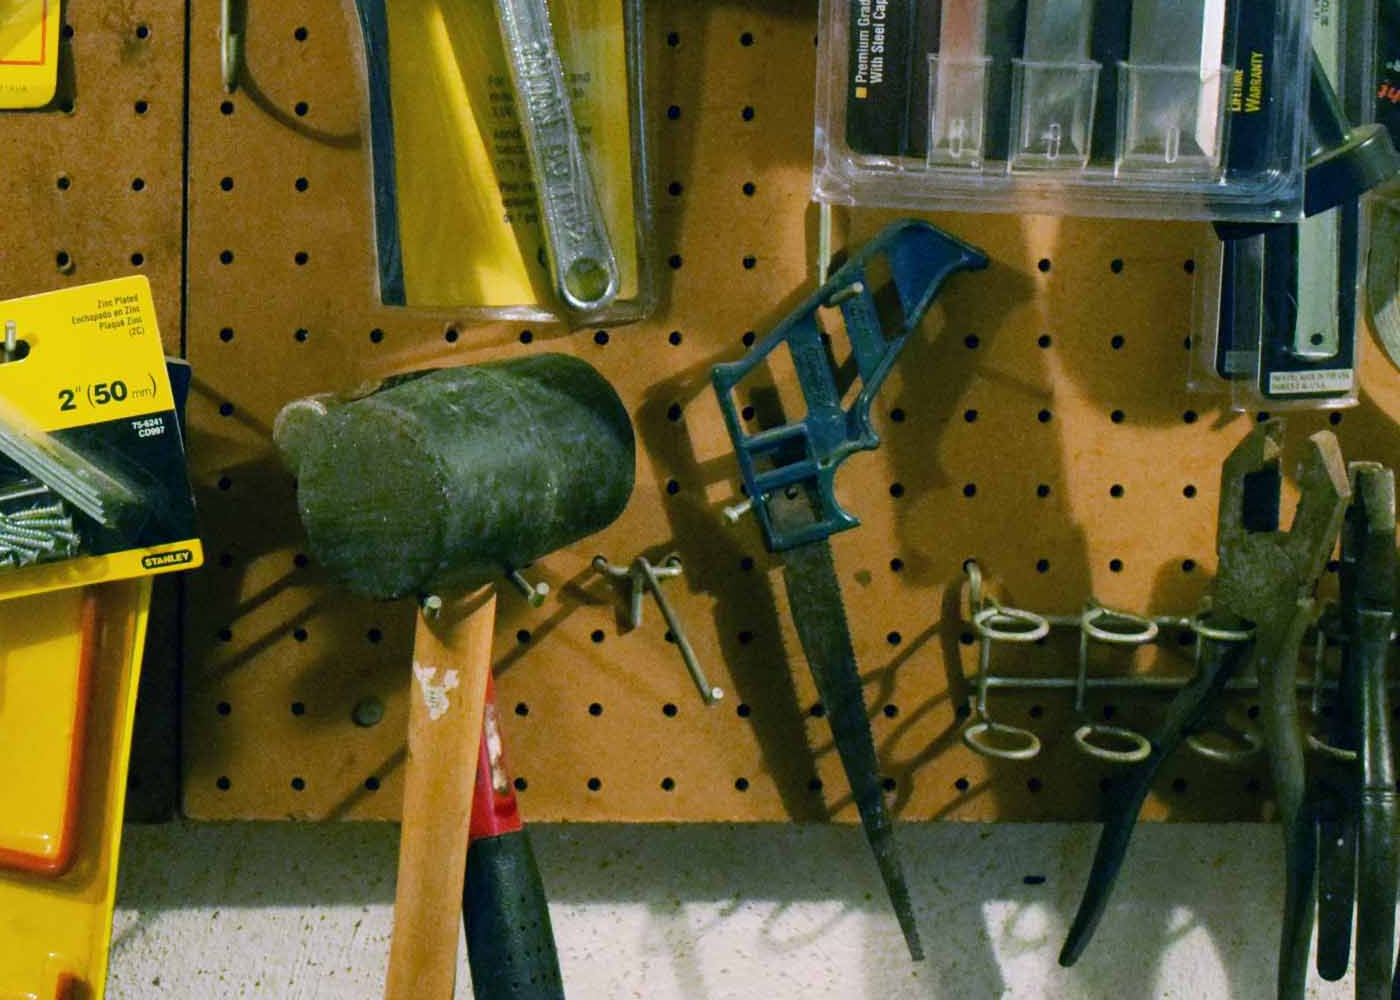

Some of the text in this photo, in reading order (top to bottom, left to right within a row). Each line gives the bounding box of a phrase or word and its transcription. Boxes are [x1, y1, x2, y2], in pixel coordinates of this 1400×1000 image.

[871, 23, 886, 54] Steel
[855, 30, 870, 84] Premium
[869, 56, 884, 85] With
[1244, 50, 1265, 113] WARRANTY
[145, 551, 190, 567] STANLEY
